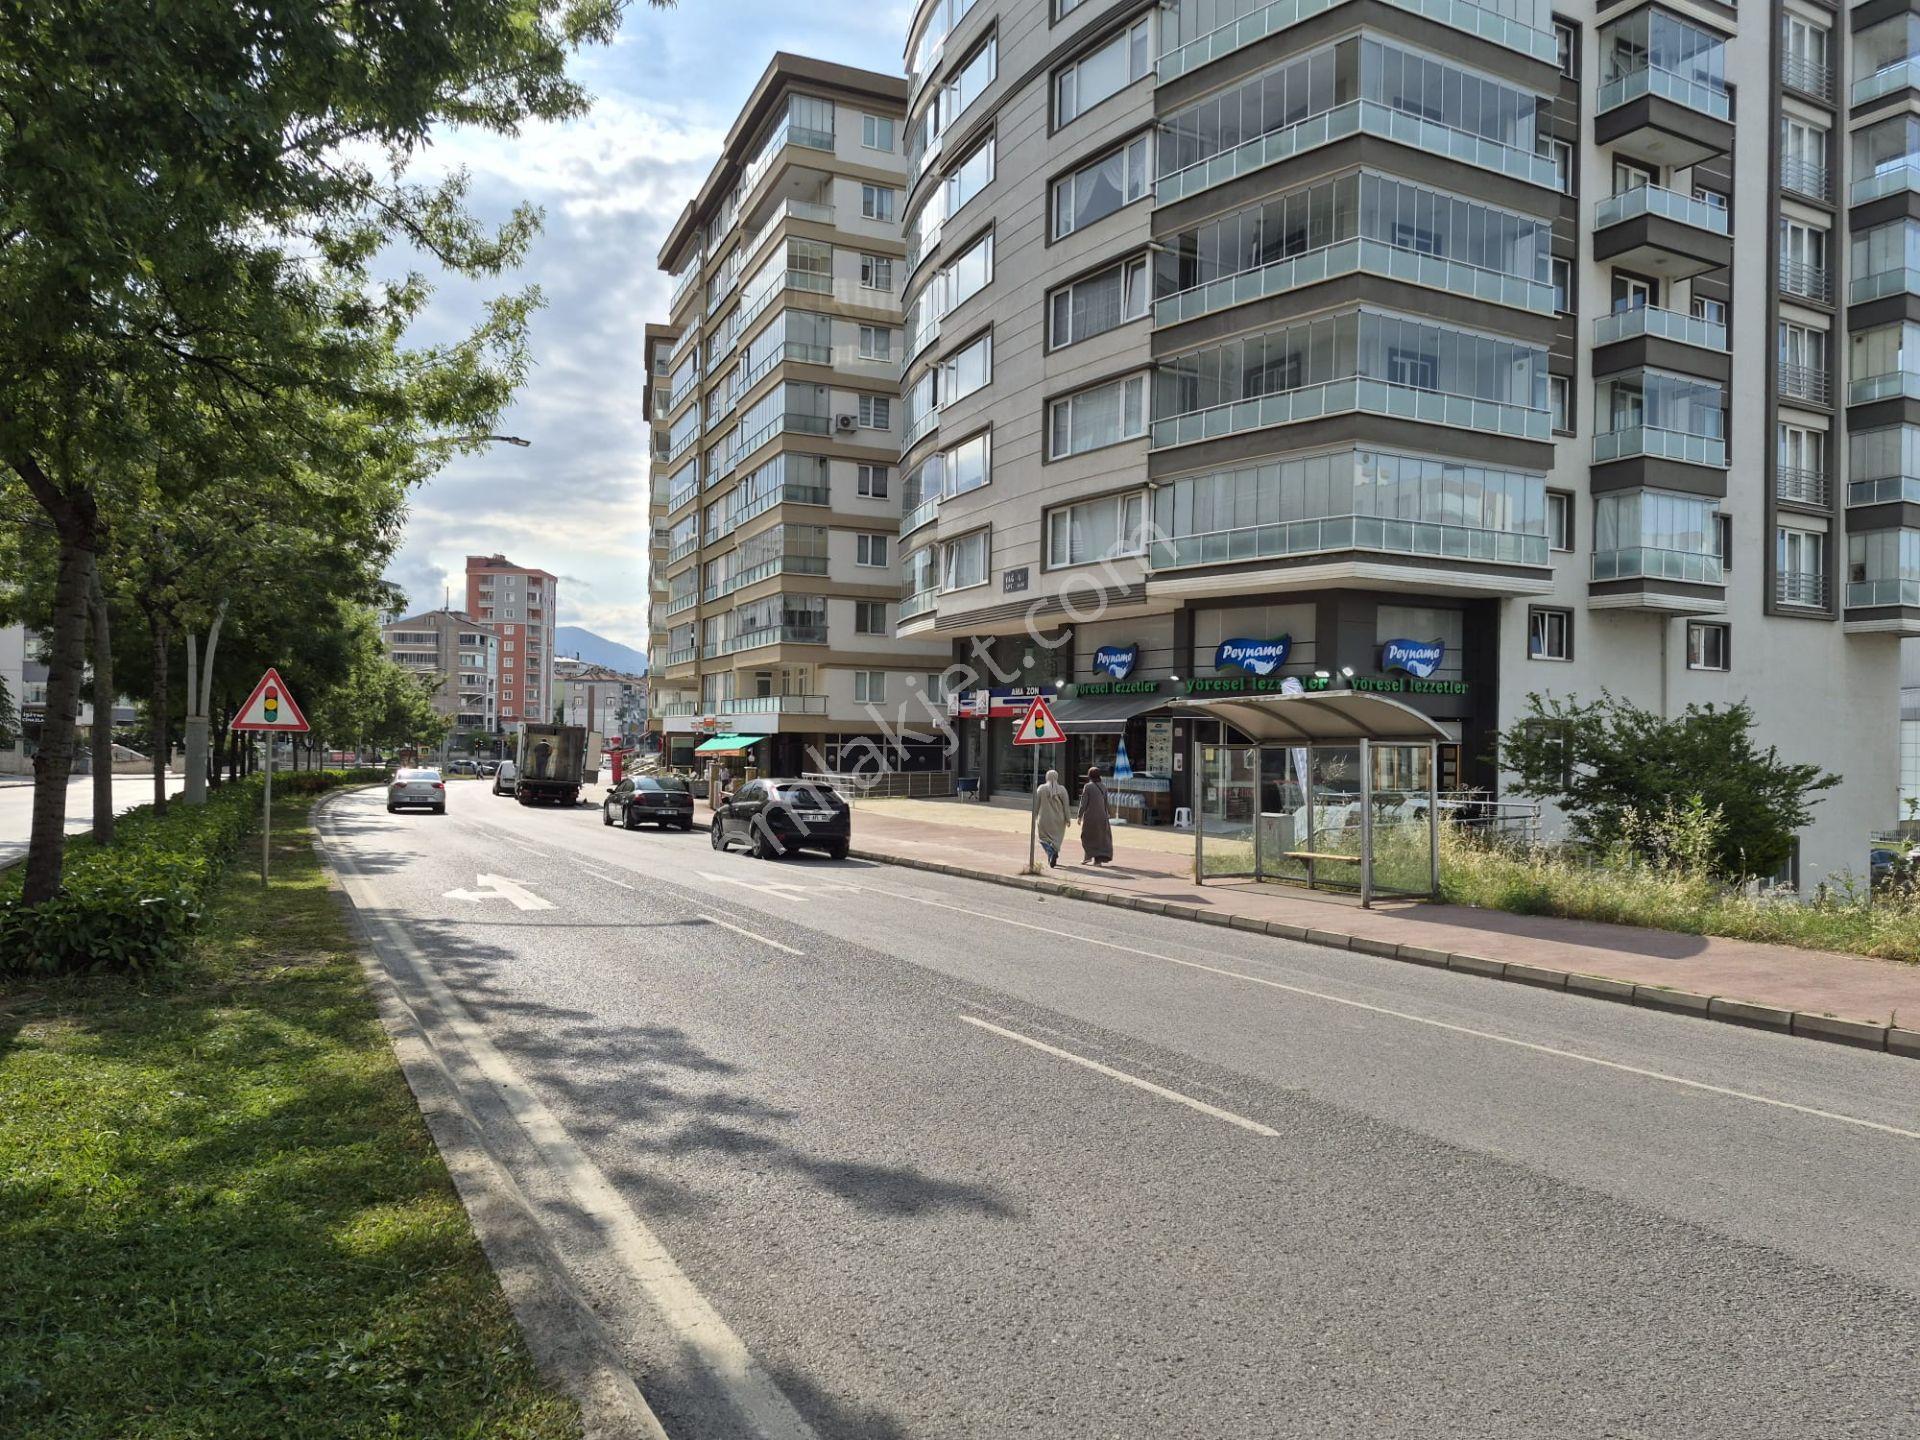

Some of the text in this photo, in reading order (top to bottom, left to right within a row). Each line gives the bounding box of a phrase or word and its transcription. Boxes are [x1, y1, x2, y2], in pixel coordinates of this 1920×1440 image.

[1097, 651, 1133, 666] Peyname
[1222, 644, 1284, 661] Peyname
[1389, 645, 1440, 661] Peyname
[1074, 680, 1157, 697] yöresel lezzetler
[1186, 676, 1329, 694] yöresel lezzler
[1350, 677, 1469, 695] yöresel lezzetler
